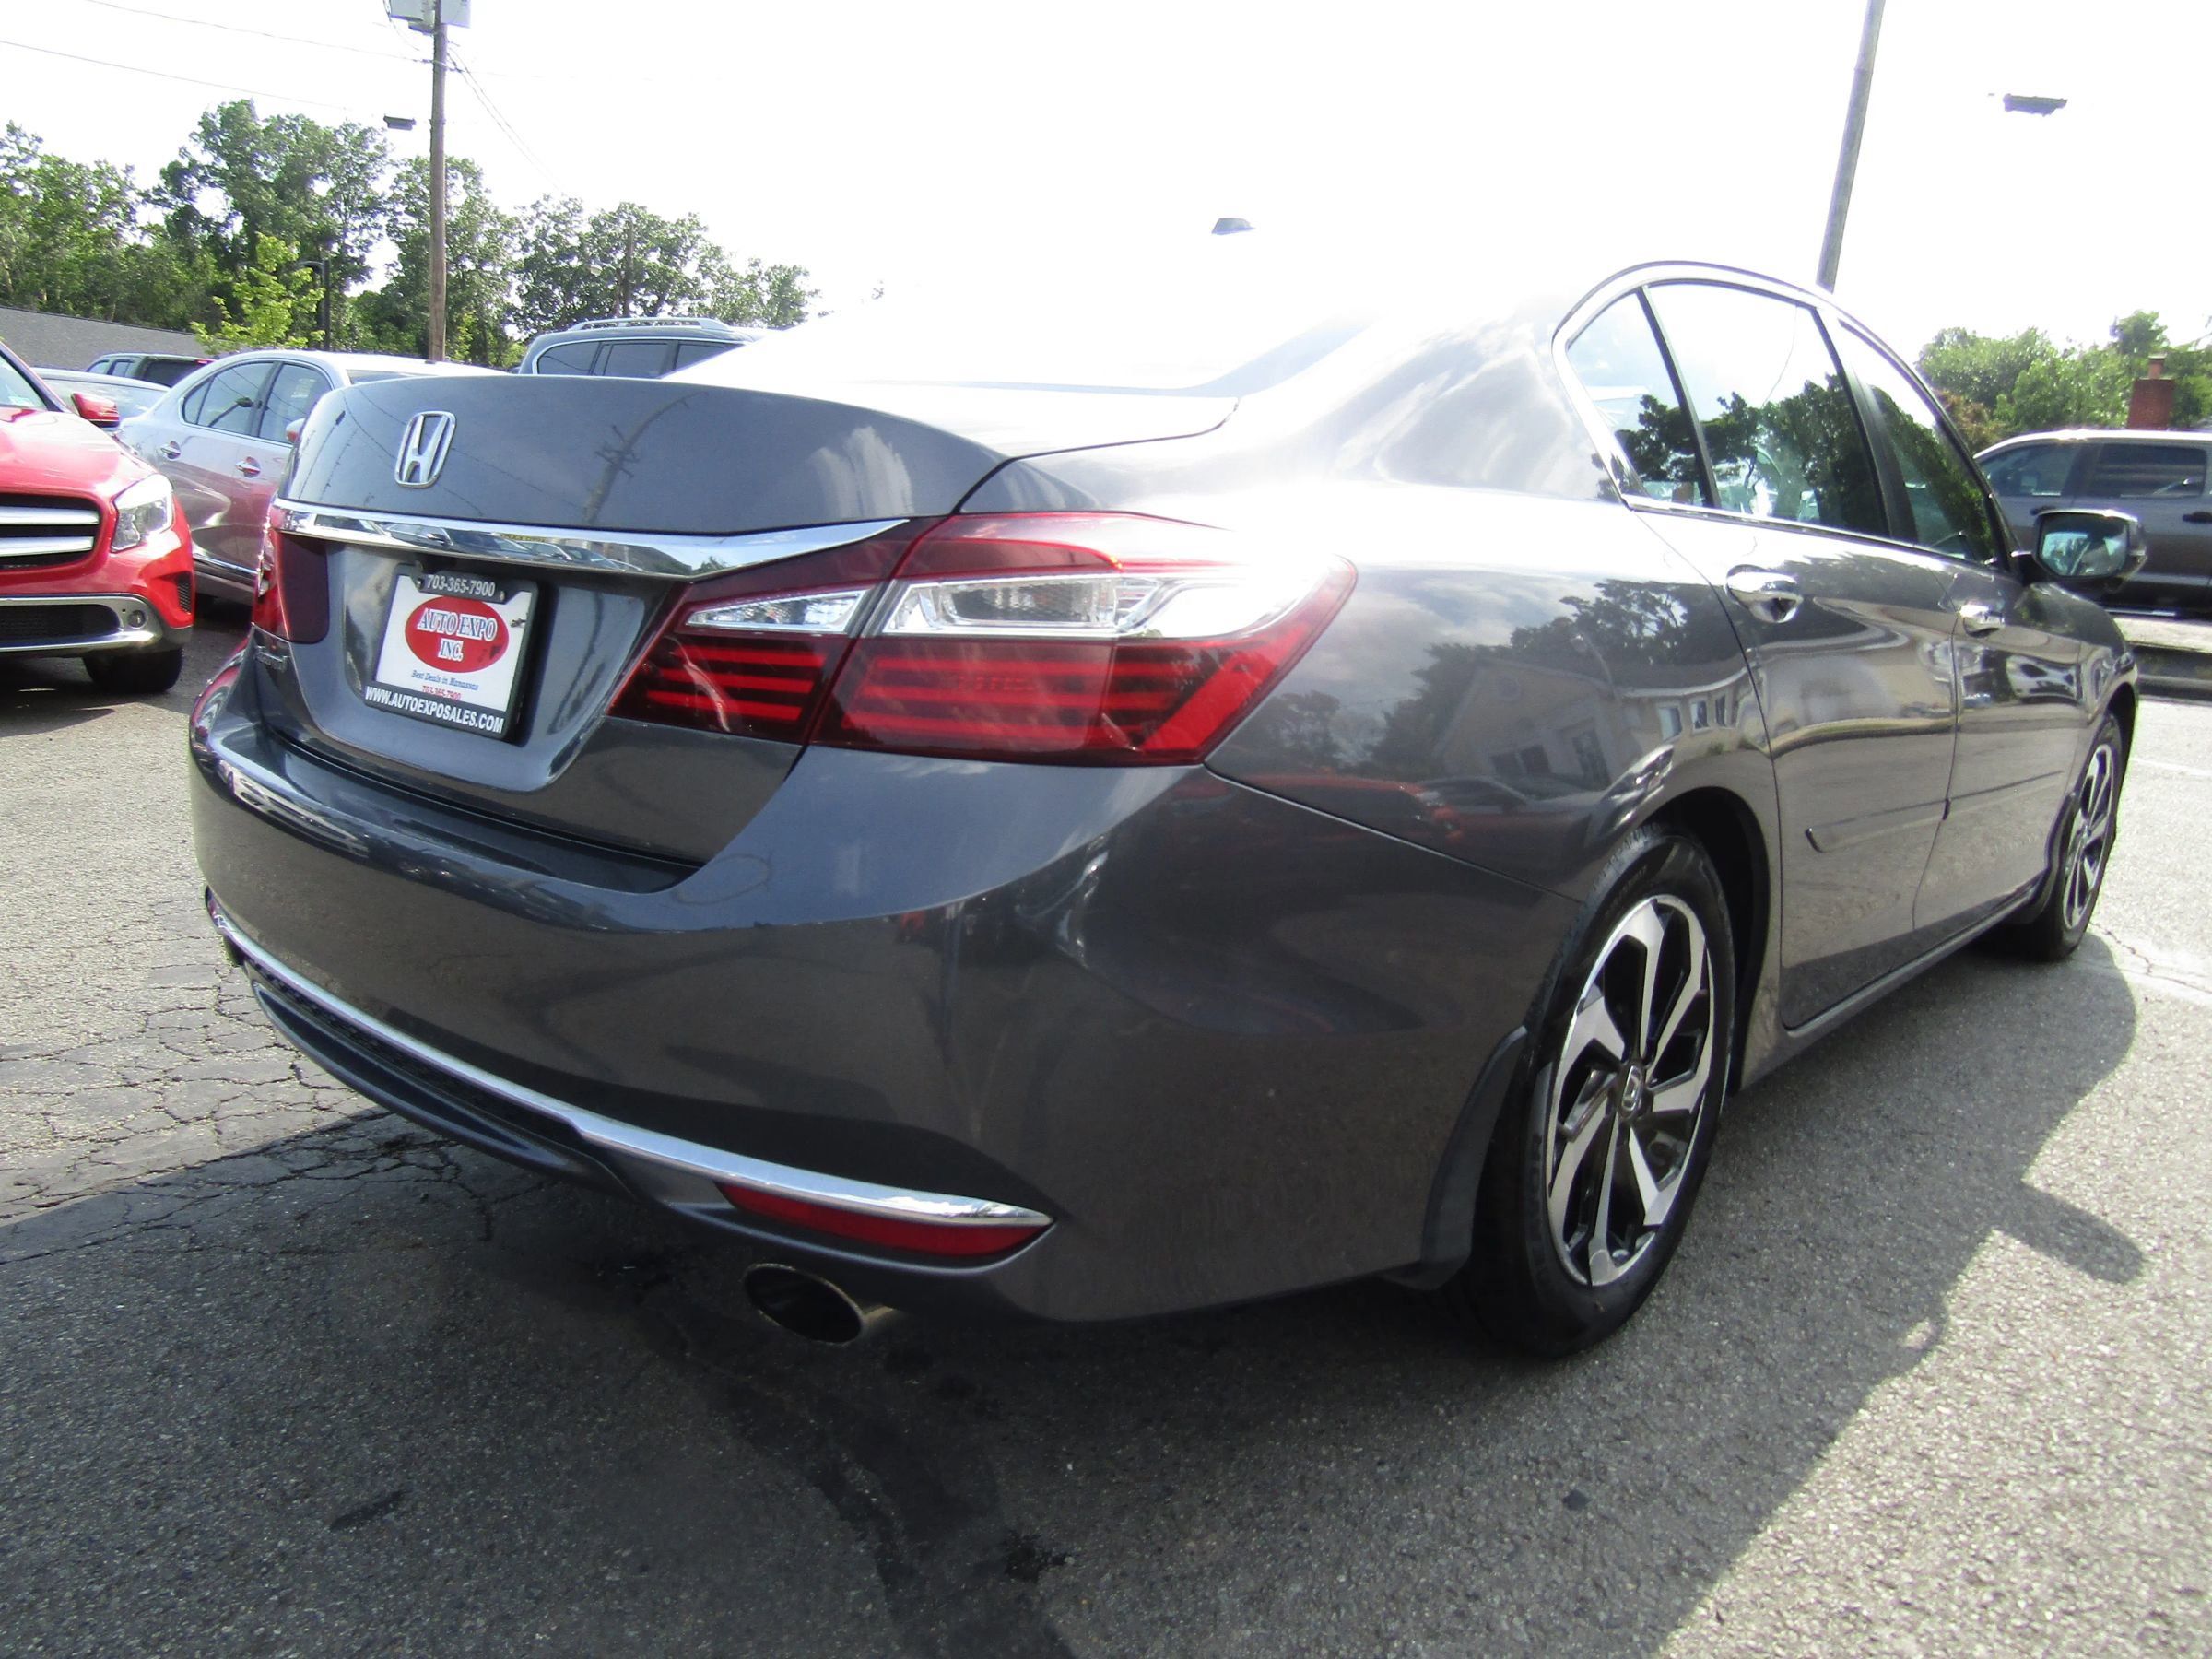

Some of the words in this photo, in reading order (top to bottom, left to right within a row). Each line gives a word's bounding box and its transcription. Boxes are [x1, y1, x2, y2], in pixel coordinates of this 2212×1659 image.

[426, 574, 496, 597] 703-365-7900
[418, 608, 459, 635] AUTO
[458, 614, 498, 641] EXPO
[438, 639, 464, 662] INC.
[365, 686, 505, 734] WWW.AUTOEXPOSALES.COM
